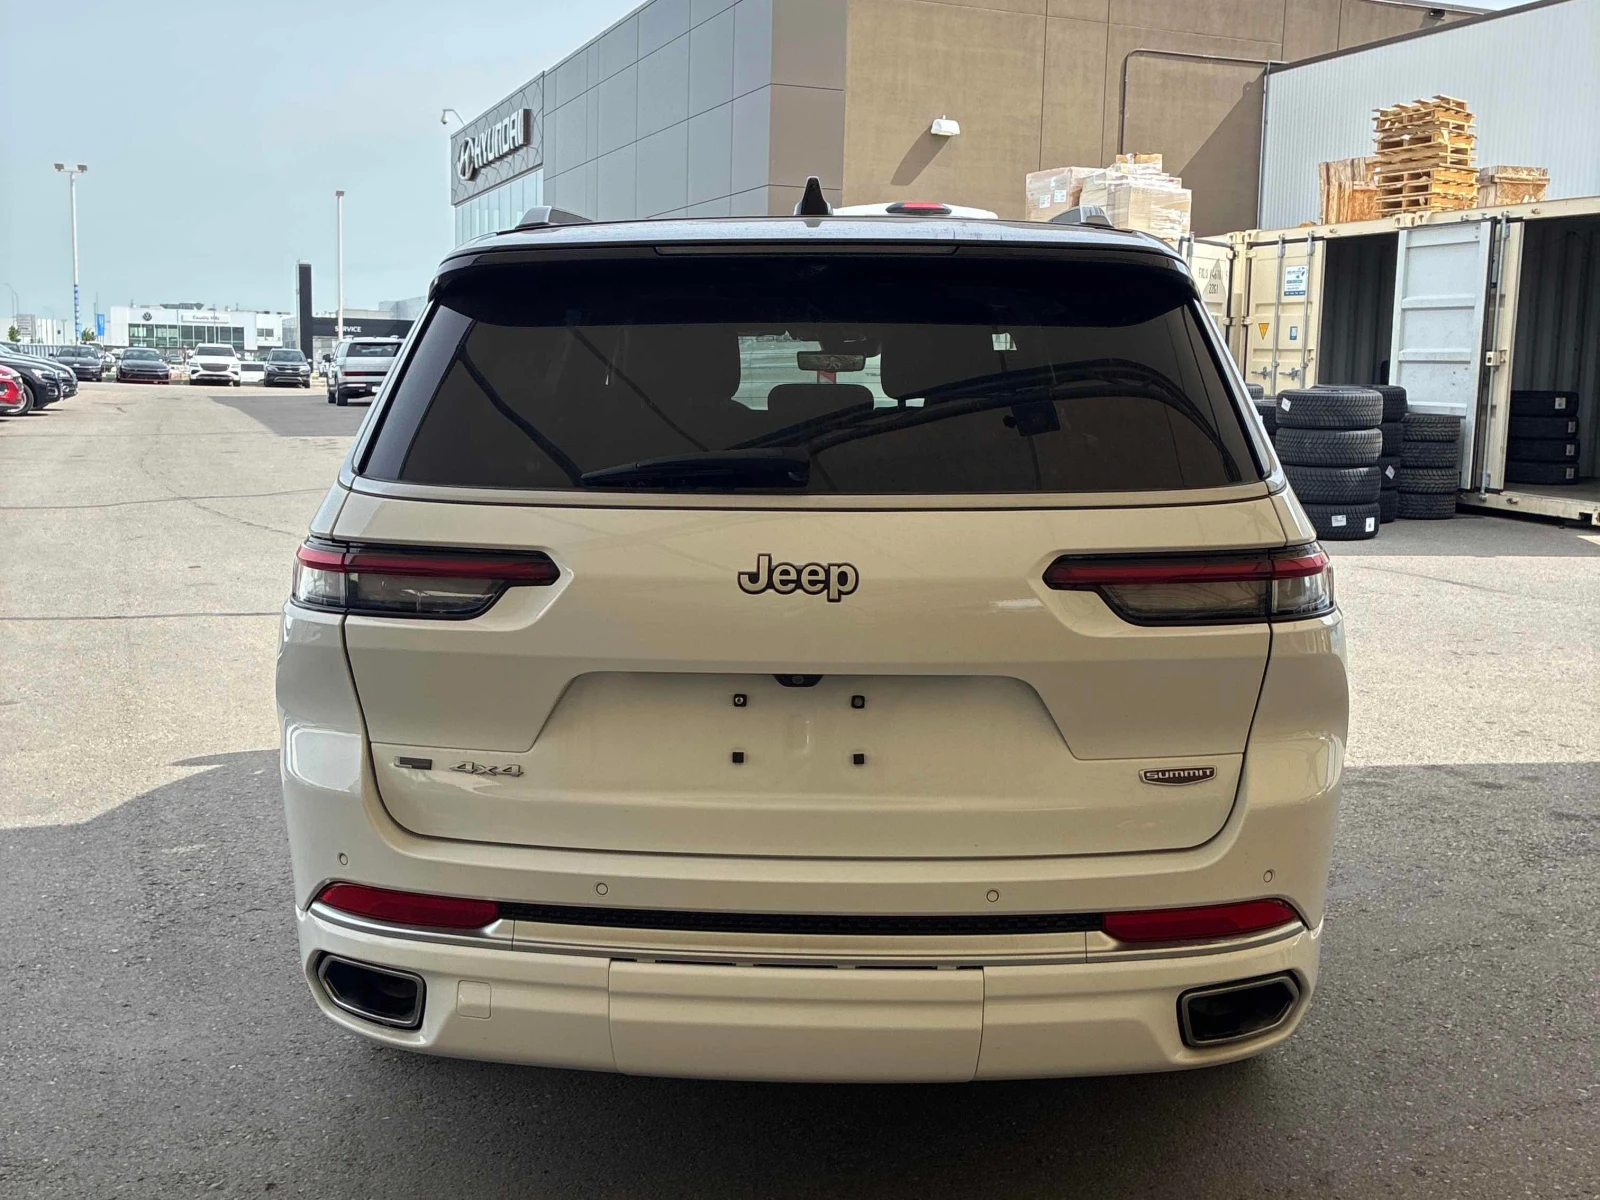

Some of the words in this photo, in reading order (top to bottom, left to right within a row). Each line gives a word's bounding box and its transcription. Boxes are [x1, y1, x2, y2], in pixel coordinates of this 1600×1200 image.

[474, 109, 526, 169] HYUNDAI
[334, 325, 362, 333] SRVICE
[737, 553, 859, 603] Jeep
[449, 761, 525, 777] 4x4
[1146, 768, 1213, 780] SUMMIT
